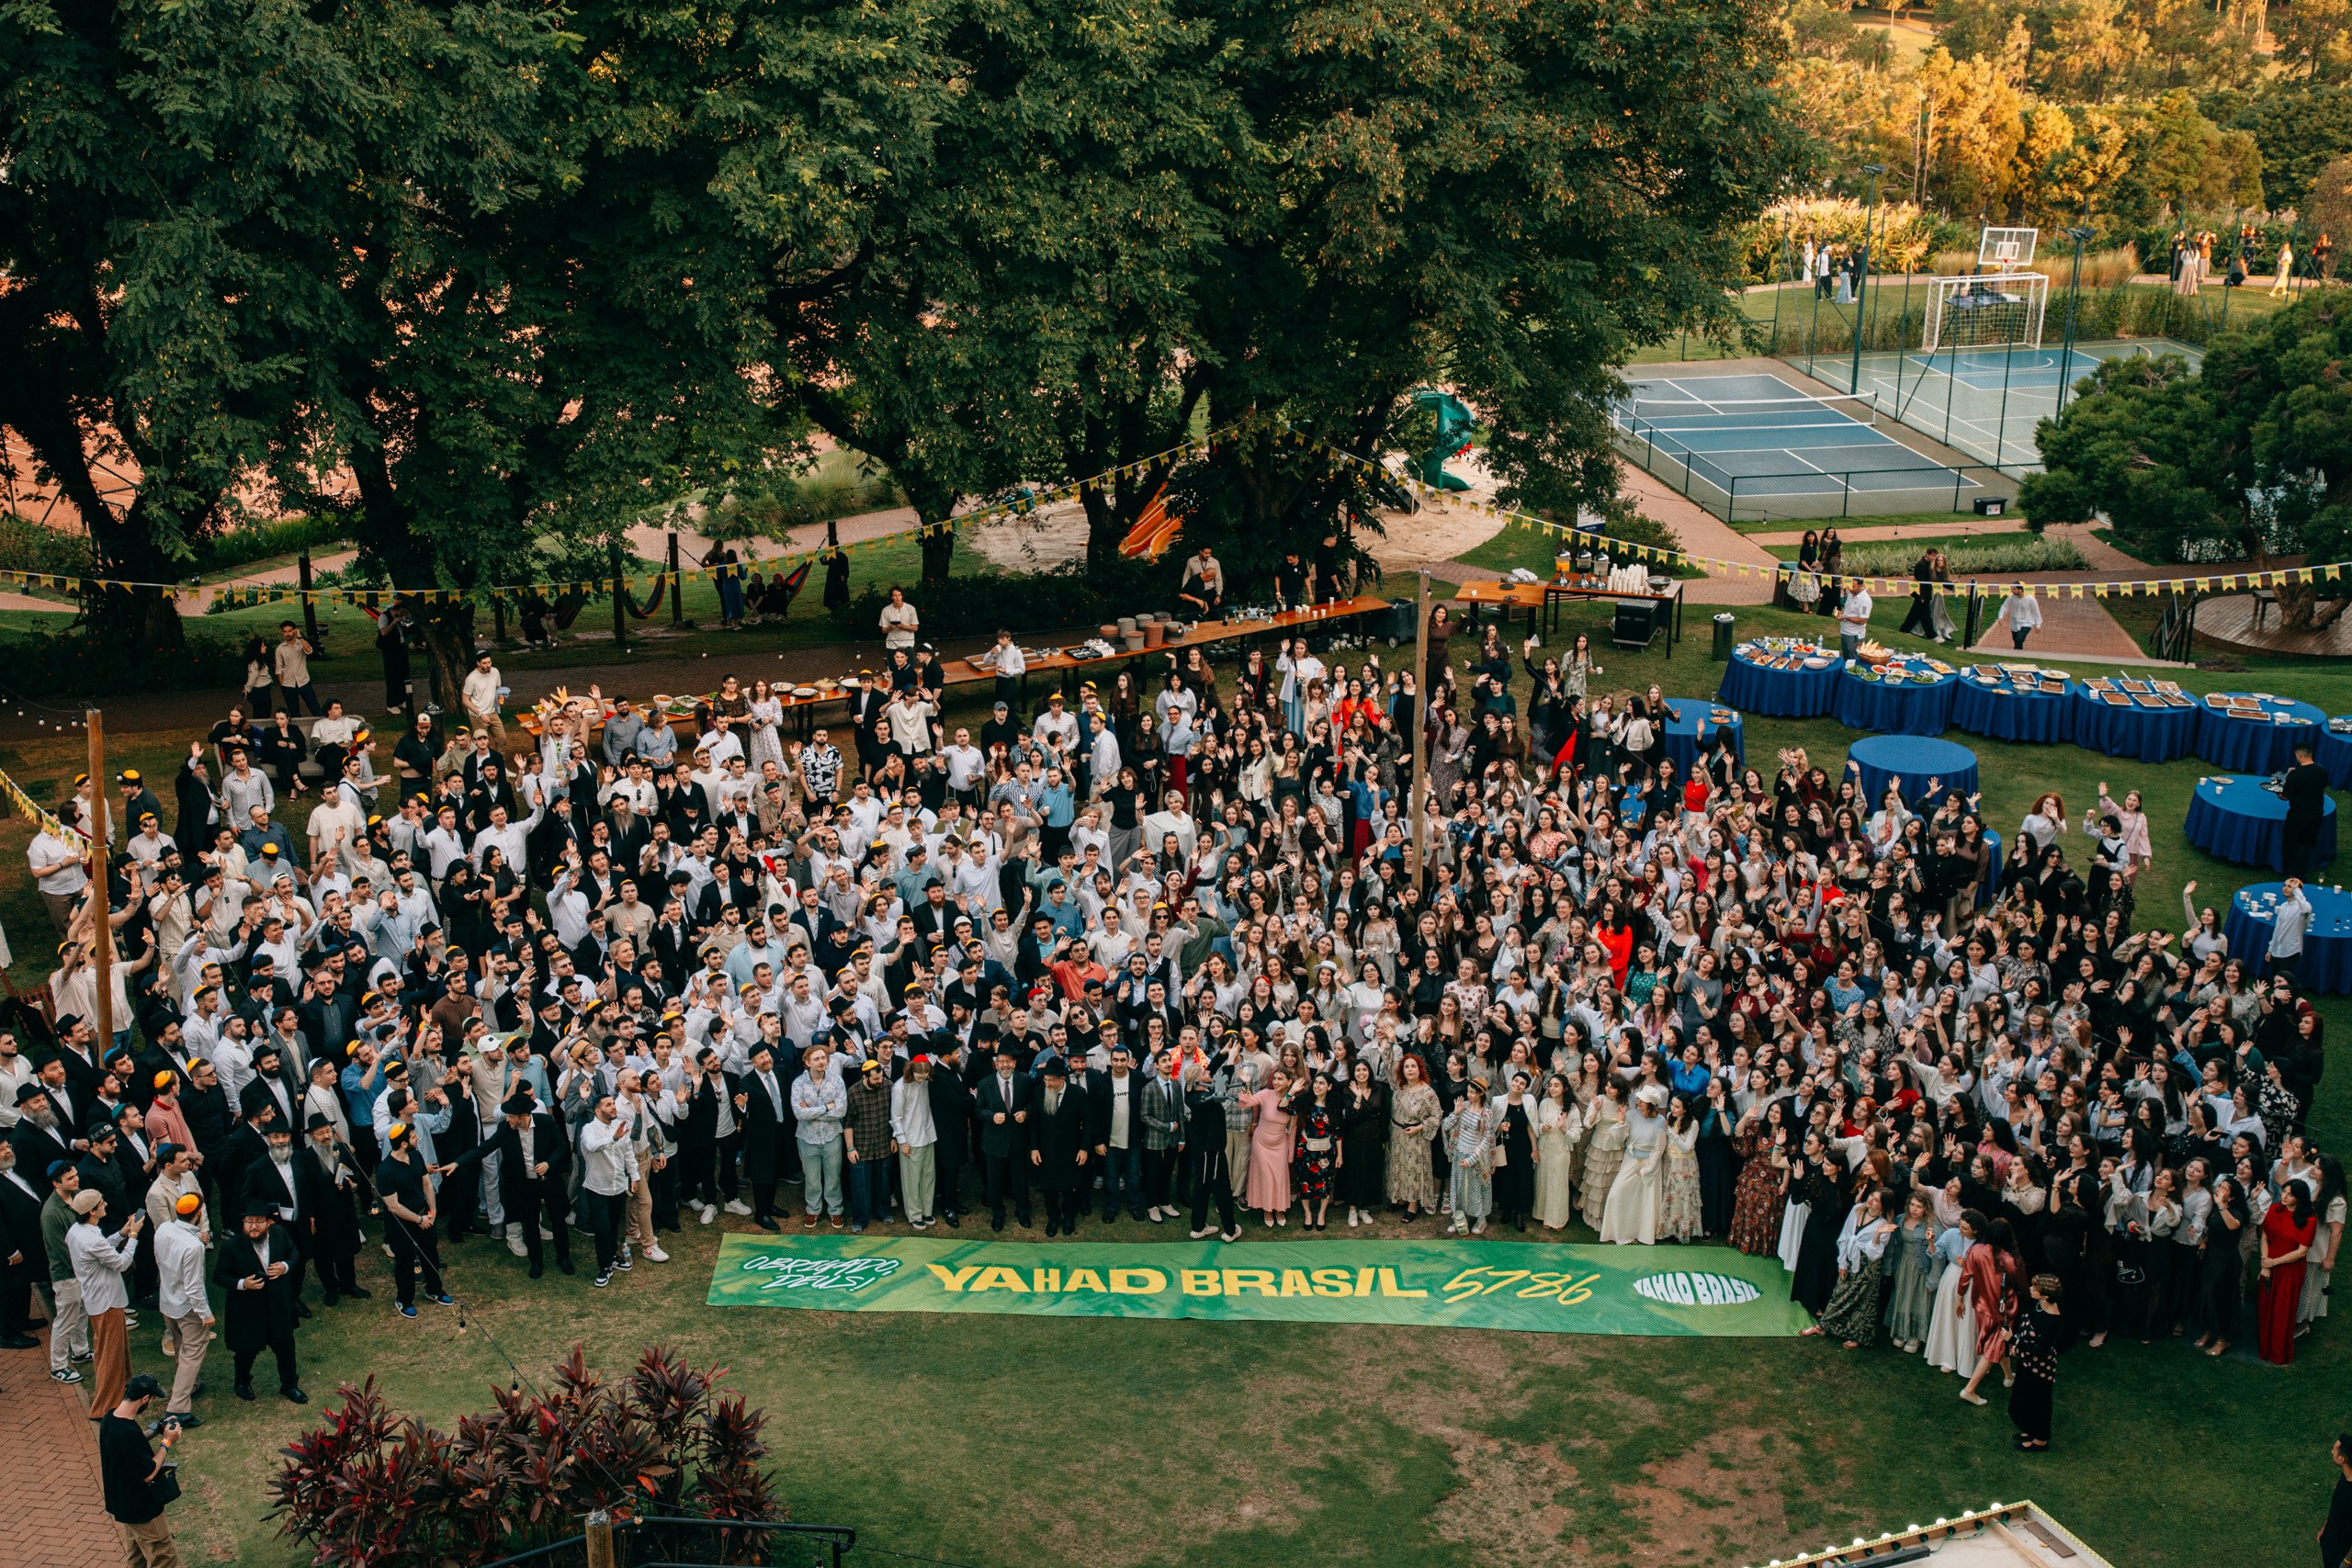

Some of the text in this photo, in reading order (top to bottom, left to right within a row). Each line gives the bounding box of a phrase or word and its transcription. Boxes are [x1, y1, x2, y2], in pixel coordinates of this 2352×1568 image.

[743, 1256, 899, 1276] OBRIGADO,
[761, 1274, 876, 1292] DEUS!
[926, 1264, 1600, 1305] YAHAD BRASIL 5786
[1633, 1272, 1761, 1305] YAHAD BRASIL
